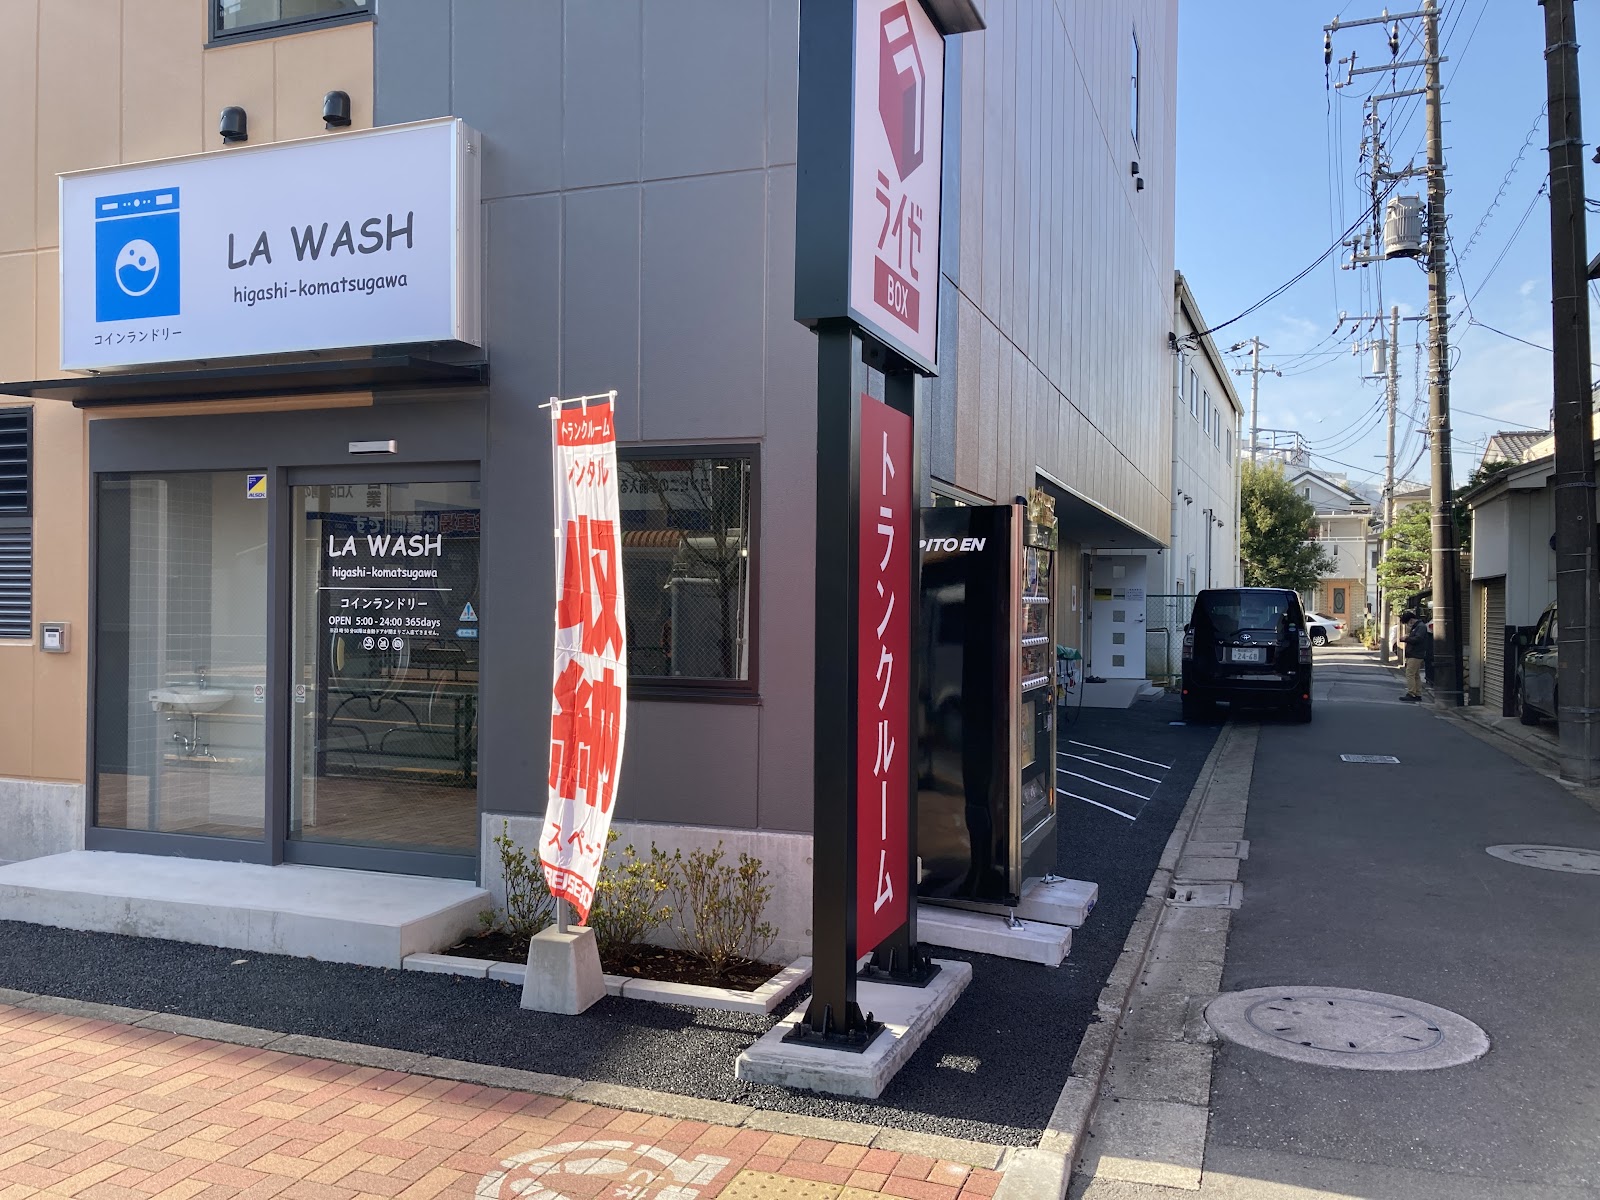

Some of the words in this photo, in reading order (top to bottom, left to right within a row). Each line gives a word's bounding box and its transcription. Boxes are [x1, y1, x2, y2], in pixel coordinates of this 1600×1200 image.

[875, 168, 923, 282] ライゼ
[227, 231, 272, 270] LA
[290, 210, 414, 262] WASH
[233, 271, 408, 307] higashi-komatsugawa
[886, 274, 909, 319] BOX
[94, 326, 182, 346] コインランドリー
[561, 417, 610, 441] トランクルーム
[328, 534, 357, 558] LA
[366, 533, 443, 558] WASH
[331, 565, 438, 581] higashi-komatsugawa
[340, 597, 428, 611] コインランドリー
[328, 616, 352, 626] OPEN
[405, 617, 441, 629] 365days
[873, 430, 896, 914] トランクルーム
